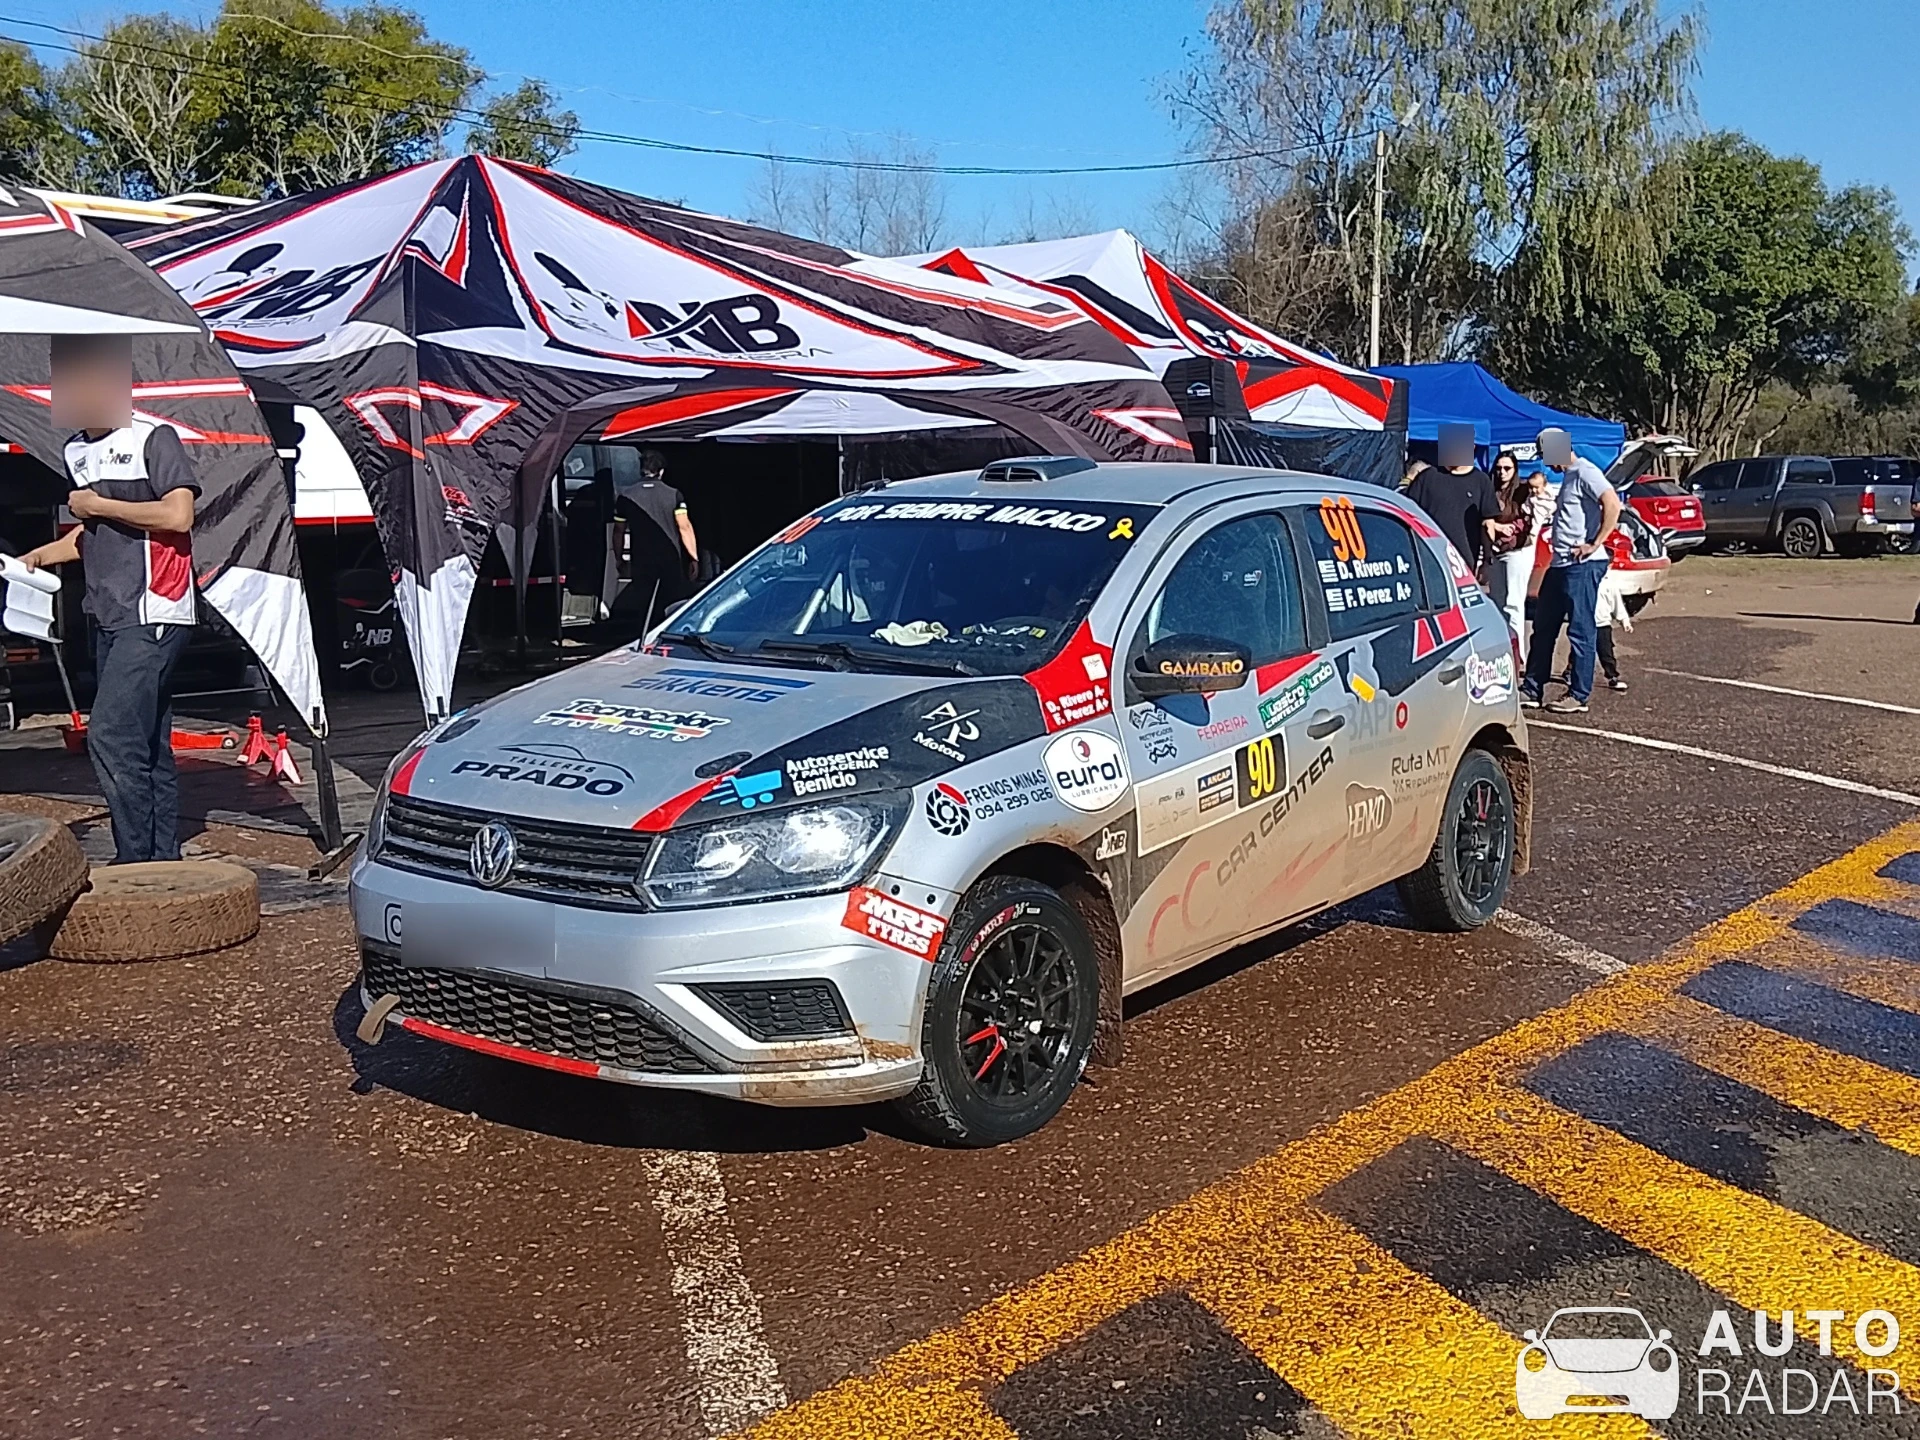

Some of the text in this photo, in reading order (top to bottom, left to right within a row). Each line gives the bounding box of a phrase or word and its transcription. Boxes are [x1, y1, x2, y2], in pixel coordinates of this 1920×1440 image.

[823, 503, 1107, 532] POR SIEMPRE MACACO
[1320, 496, 1366, 562] 90
[1337, 555, 1410, 580] D. Rivero A-
[1344, 582, 1412, 608] F. Perez A+
[1160, 659, 1244, 676] GAMBARO
[621, 678, 788, 703] sikkens
[1045, 685, 1106, 714] D. Rivero A-
[564, 699, 728, 729] Tecnocolor
[1052, 698, 1110, 727] F. Perez A+
[1265, 697, 1306, 729] CARTELES
[534, 716, 696, 741] PINTURAS
[1196, 714, 1250, 741] FERREIRA
[786, 746, 890, 774] Autoservice
[912, 731, 966, 763] Motors
[1391, 745, 1451, 777] Ruta MT
[450, 760, 625, 796] PRADO
[509, 756, 598, 773] TALLERES
[789, 759, 880, 782] Y PANADERIA
[1056, 753, 1123, 790] eurol
[1207, 769, 1232, 787] ANCAP
[1247, 738, 1275, 798] 90
[793, 772, 858, 797] Benicio
[964, 769, 1047, 806] FRENOS MINAS
[1071, 783, 1120, 798] LUBRICANTS
[975, 786, 1054, 820] 094 299 026
[1217, 830, 1258, 886] CAR
[859, 894, 945, 939] MRF
[979, 911, 1005, 943] MRF
[867, 915, 931, 955] TYRES
